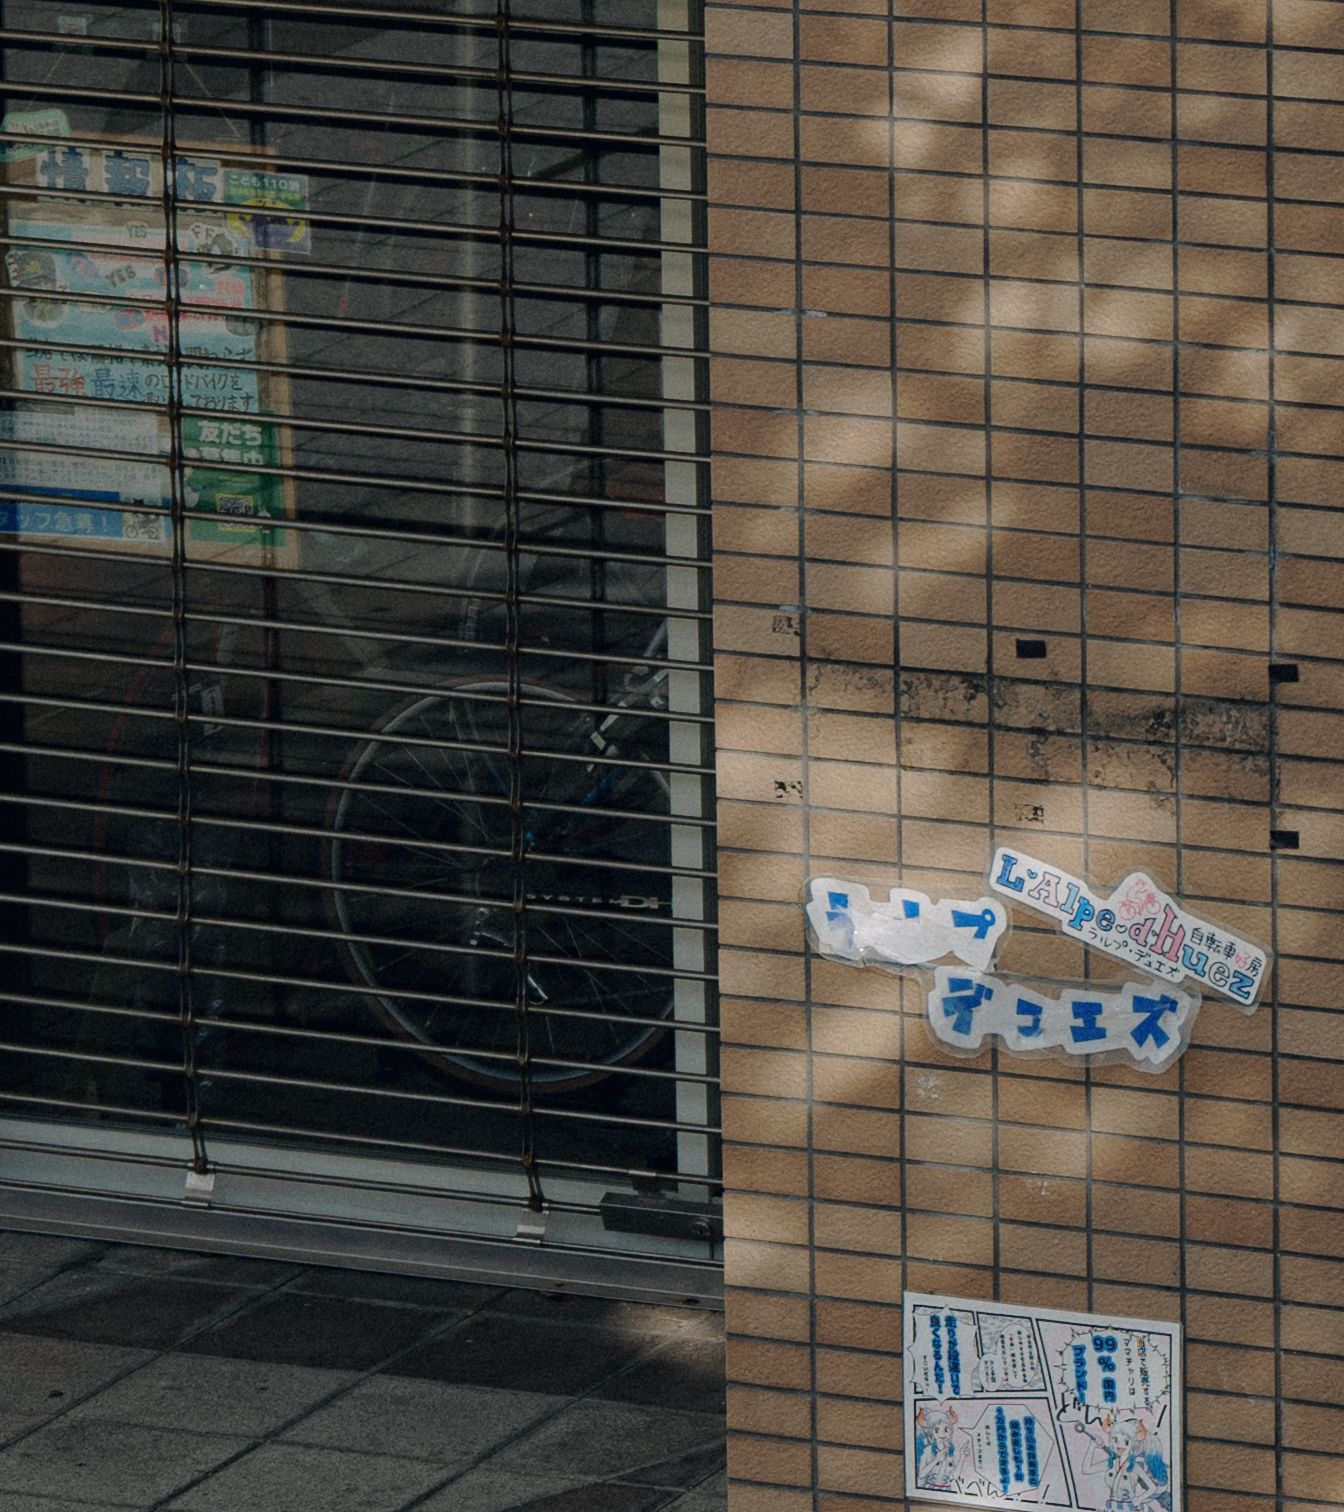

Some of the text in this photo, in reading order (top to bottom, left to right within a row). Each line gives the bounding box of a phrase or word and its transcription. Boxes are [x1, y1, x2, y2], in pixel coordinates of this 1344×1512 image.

[198, 419, 263, 447] 友だち
[941, 977, 1178, 1050] デュエズ
